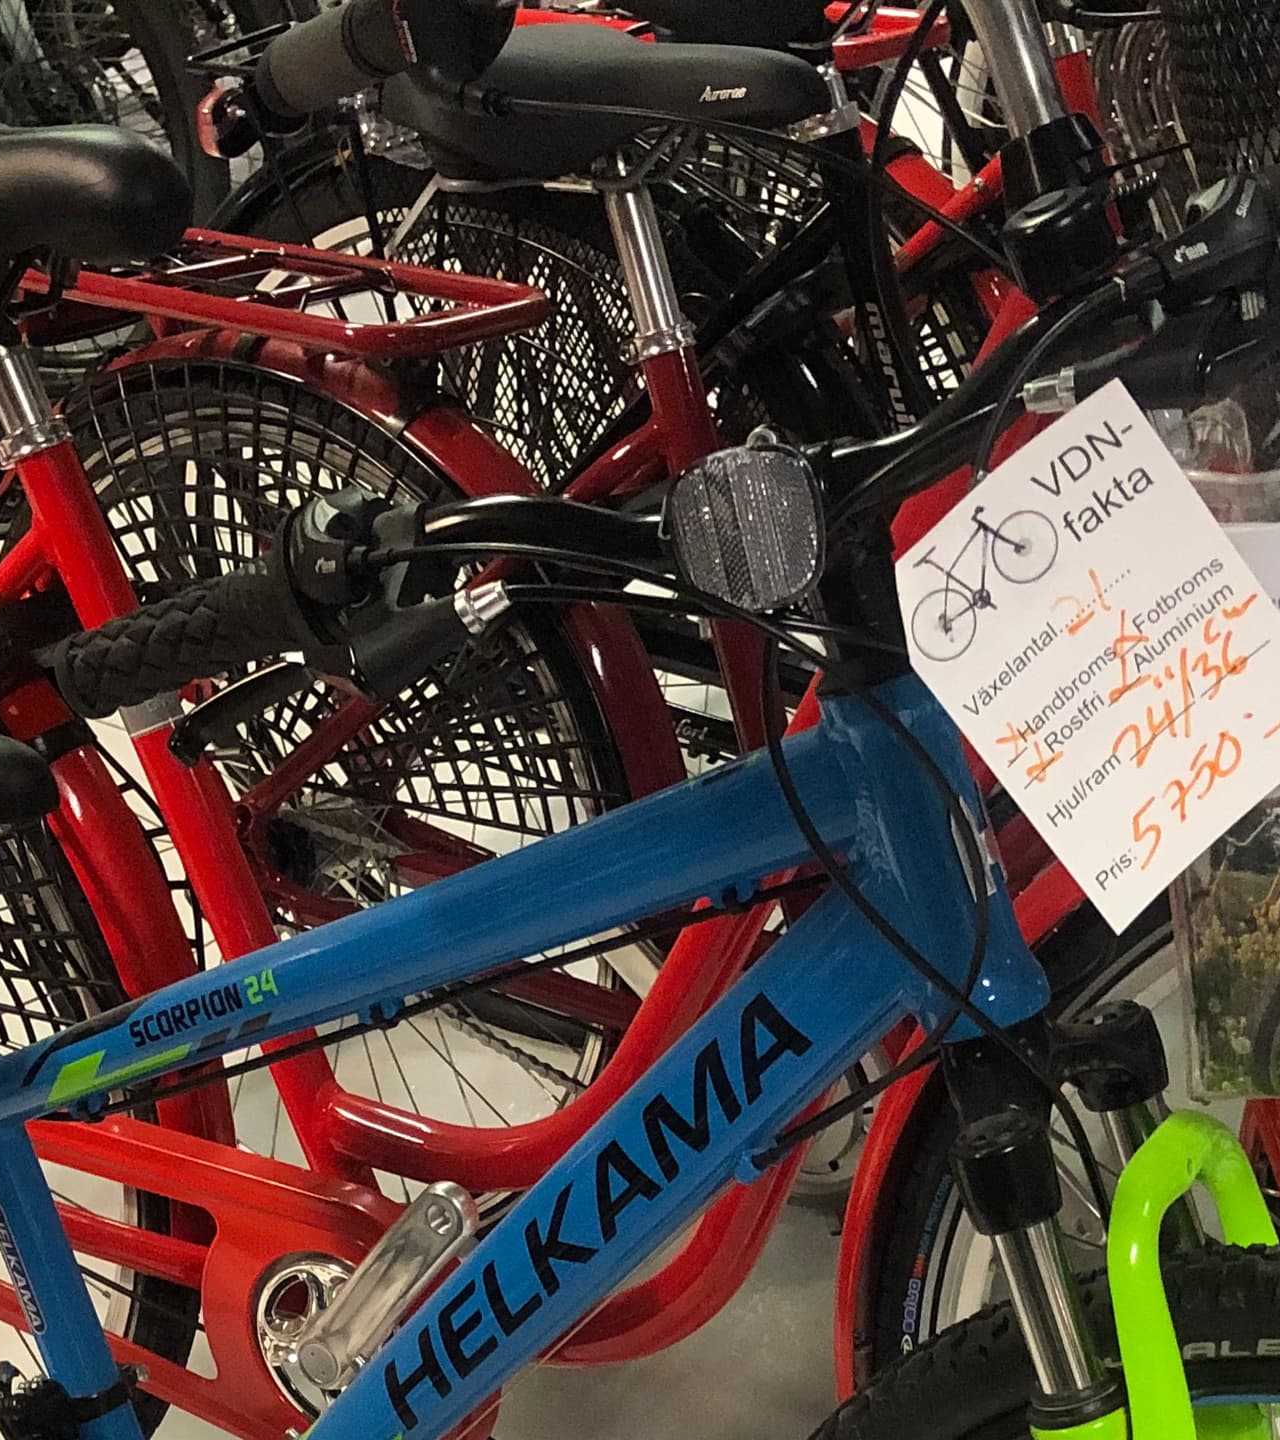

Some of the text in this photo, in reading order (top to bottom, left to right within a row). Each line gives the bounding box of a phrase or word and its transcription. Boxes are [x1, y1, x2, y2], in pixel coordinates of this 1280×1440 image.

[1029, 420, 1133, 498] VDN-
[1062, 466, 1155, 543] fakta
[962, 621, 1060, 717] Växelantal
[1016, 557, 1225, 744] Handbroms Fotbroms
[1043, 584, 1235, 755] Rostfri Aluminium
[1045, 754, 1122, 828] Hjul/ram
[1094, 848, 1139, 892] Pris:
[129, 968, 280, 1049] SCORPION 24
[384, 991, 813, 1432] HELKAMA
